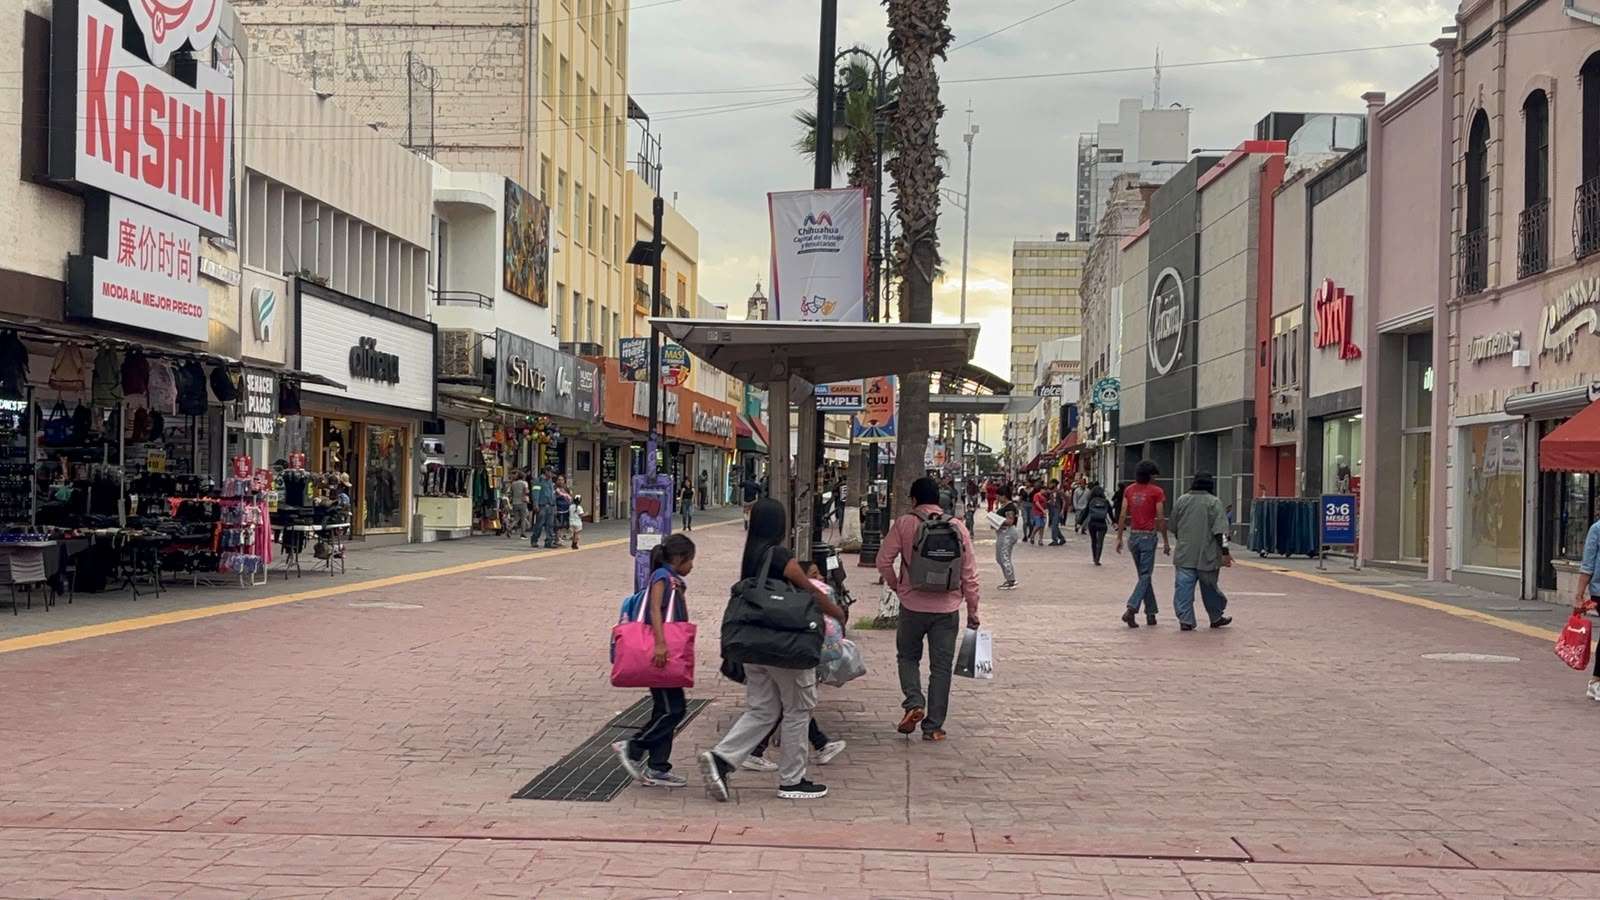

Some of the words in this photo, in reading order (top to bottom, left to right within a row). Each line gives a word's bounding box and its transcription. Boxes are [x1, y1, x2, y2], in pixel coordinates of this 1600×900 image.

[86, 14, 226, 217] KASHIN
[798, 226, 839, 235] Chihuahua
[117, 217, 192, 283] 廉价时尚
[102, 281, 128, 301] MODA
[130, 289, 141, 304] AL
[143, 292, 171, 312] MEJOR
[172, 299, 202, 318] PRECIO
[512, 355, 546, 392] Silvia
[867, 396, 888, 405] CUU
